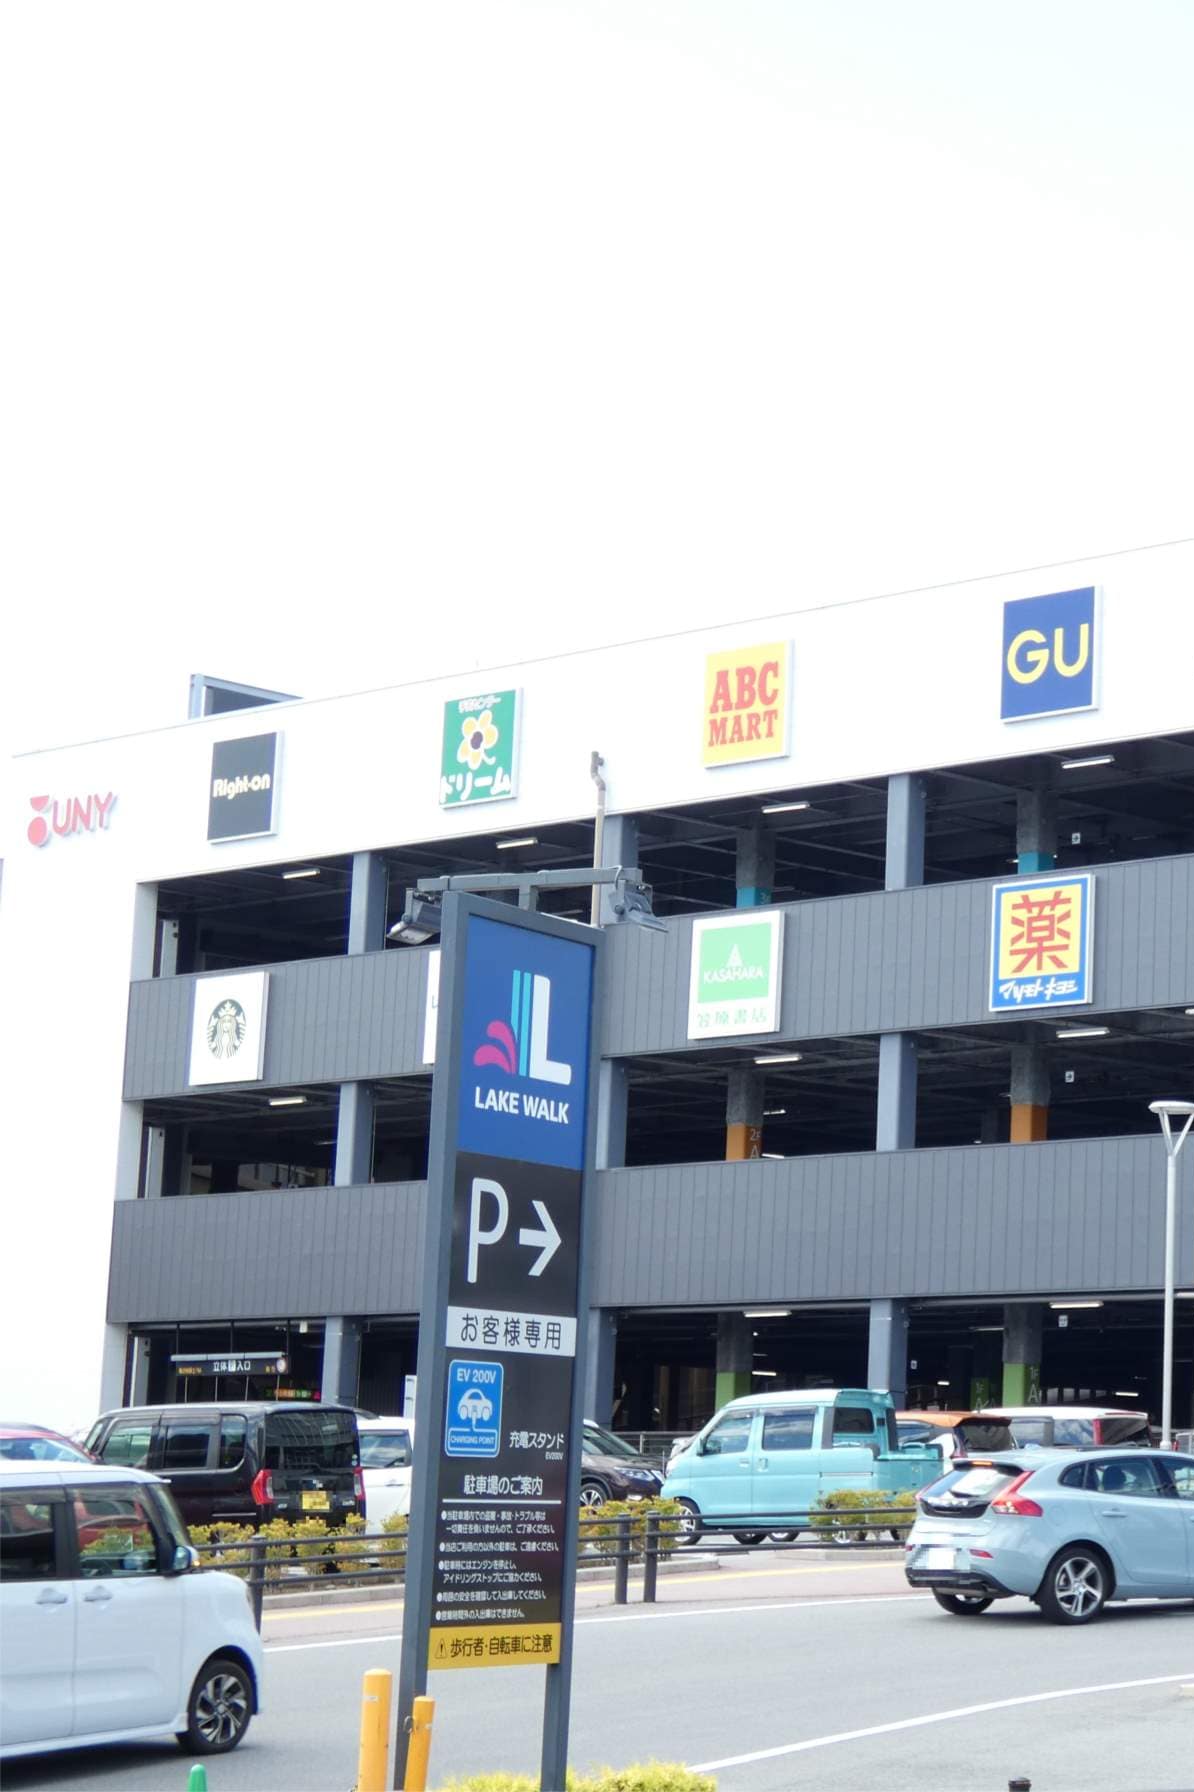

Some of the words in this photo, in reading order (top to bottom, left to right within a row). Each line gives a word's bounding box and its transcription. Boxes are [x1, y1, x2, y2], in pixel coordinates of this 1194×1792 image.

[1007, 623, 1089, 684] GU
[709, 661, 779, 714] ABC
[708, 709, 778, 747] MART
[213, 772, 271, 801] Right-on
[439, 766, 512, 804] ドリーム
[52, 791, 115, 835] UNY
[1010, 890, 1072, 974] 薬
[704, 965, 764, 984] KASAHARA
[475, 1086, 519, 1114] LAKE
[523, 1094, 569, 1124] WALK
[467, 1177, 509, 1284] P
[461, 1313, 561, 1350] お客様専用
[457, 1368, 469, 1382] EV
[473, 1371, 497, 1384] 200V
[450, 1434, 477, 1444] CHARGING
[479, 1436, 495, 1445] POINT
[509, 1431, 565, 1449] 充電スタンド
[464, 1474, 543, 1496] 駐車場のご案内
[451, 1634, 552, 1659] 歩行者・自転車に注意
